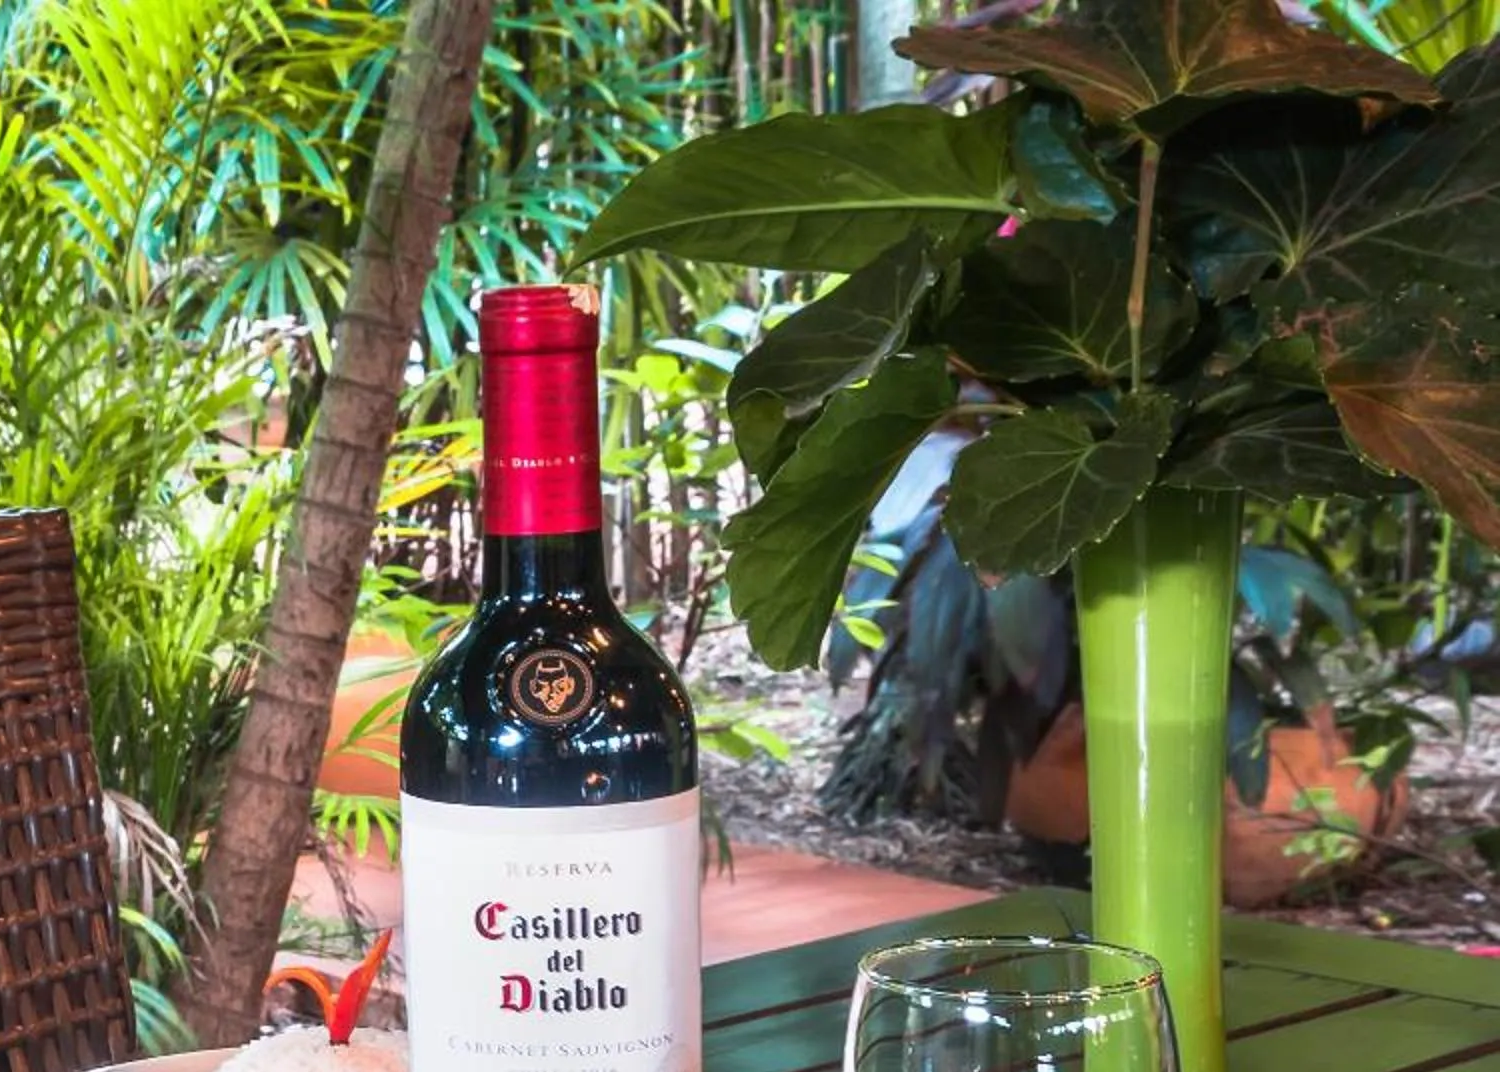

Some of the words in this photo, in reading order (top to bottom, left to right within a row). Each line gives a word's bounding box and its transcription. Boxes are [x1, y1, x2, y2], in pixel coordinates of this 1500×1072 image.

[504, 860, 613, 878] RESERVA
[474, 901, 642, 941] Casillero
[547, 949, 584, 973] del
[499, 974, 628, 1013] Diablo
[448, 1034, 549, 1057] CABERNET
[557, 1033, 674, 1058] SAUVIGNON
